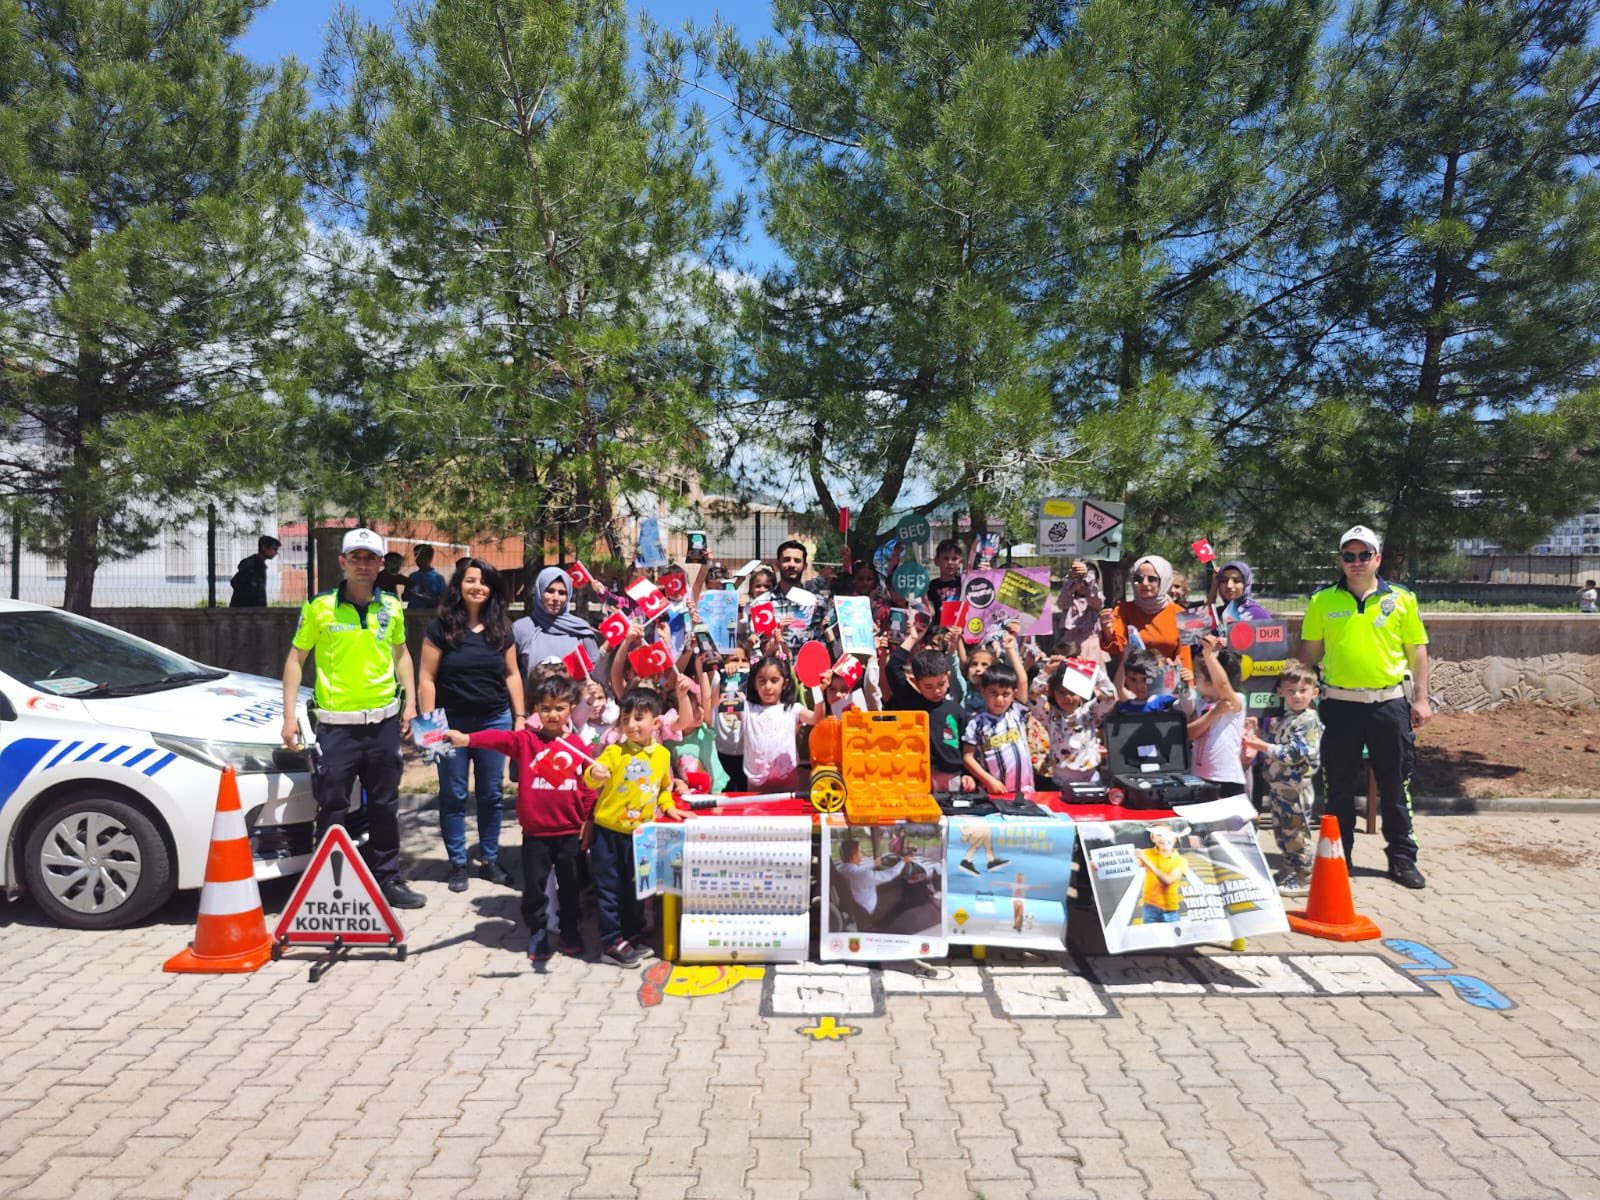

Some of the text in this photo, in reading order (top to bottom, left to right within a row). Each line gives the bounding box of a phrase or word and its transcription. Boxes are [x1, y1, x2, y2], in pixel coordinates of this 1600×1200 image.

[1093, 513, 1106, 524] YOL
[1088, 520, 1103, 531] VER
[1259, 628, 1281, 639] DUR
[1254, 694, 1276, 706] GEÇ
[305, 898, 371, 916] TRAFİK
[296, 917, 382, 932] KONTROL
